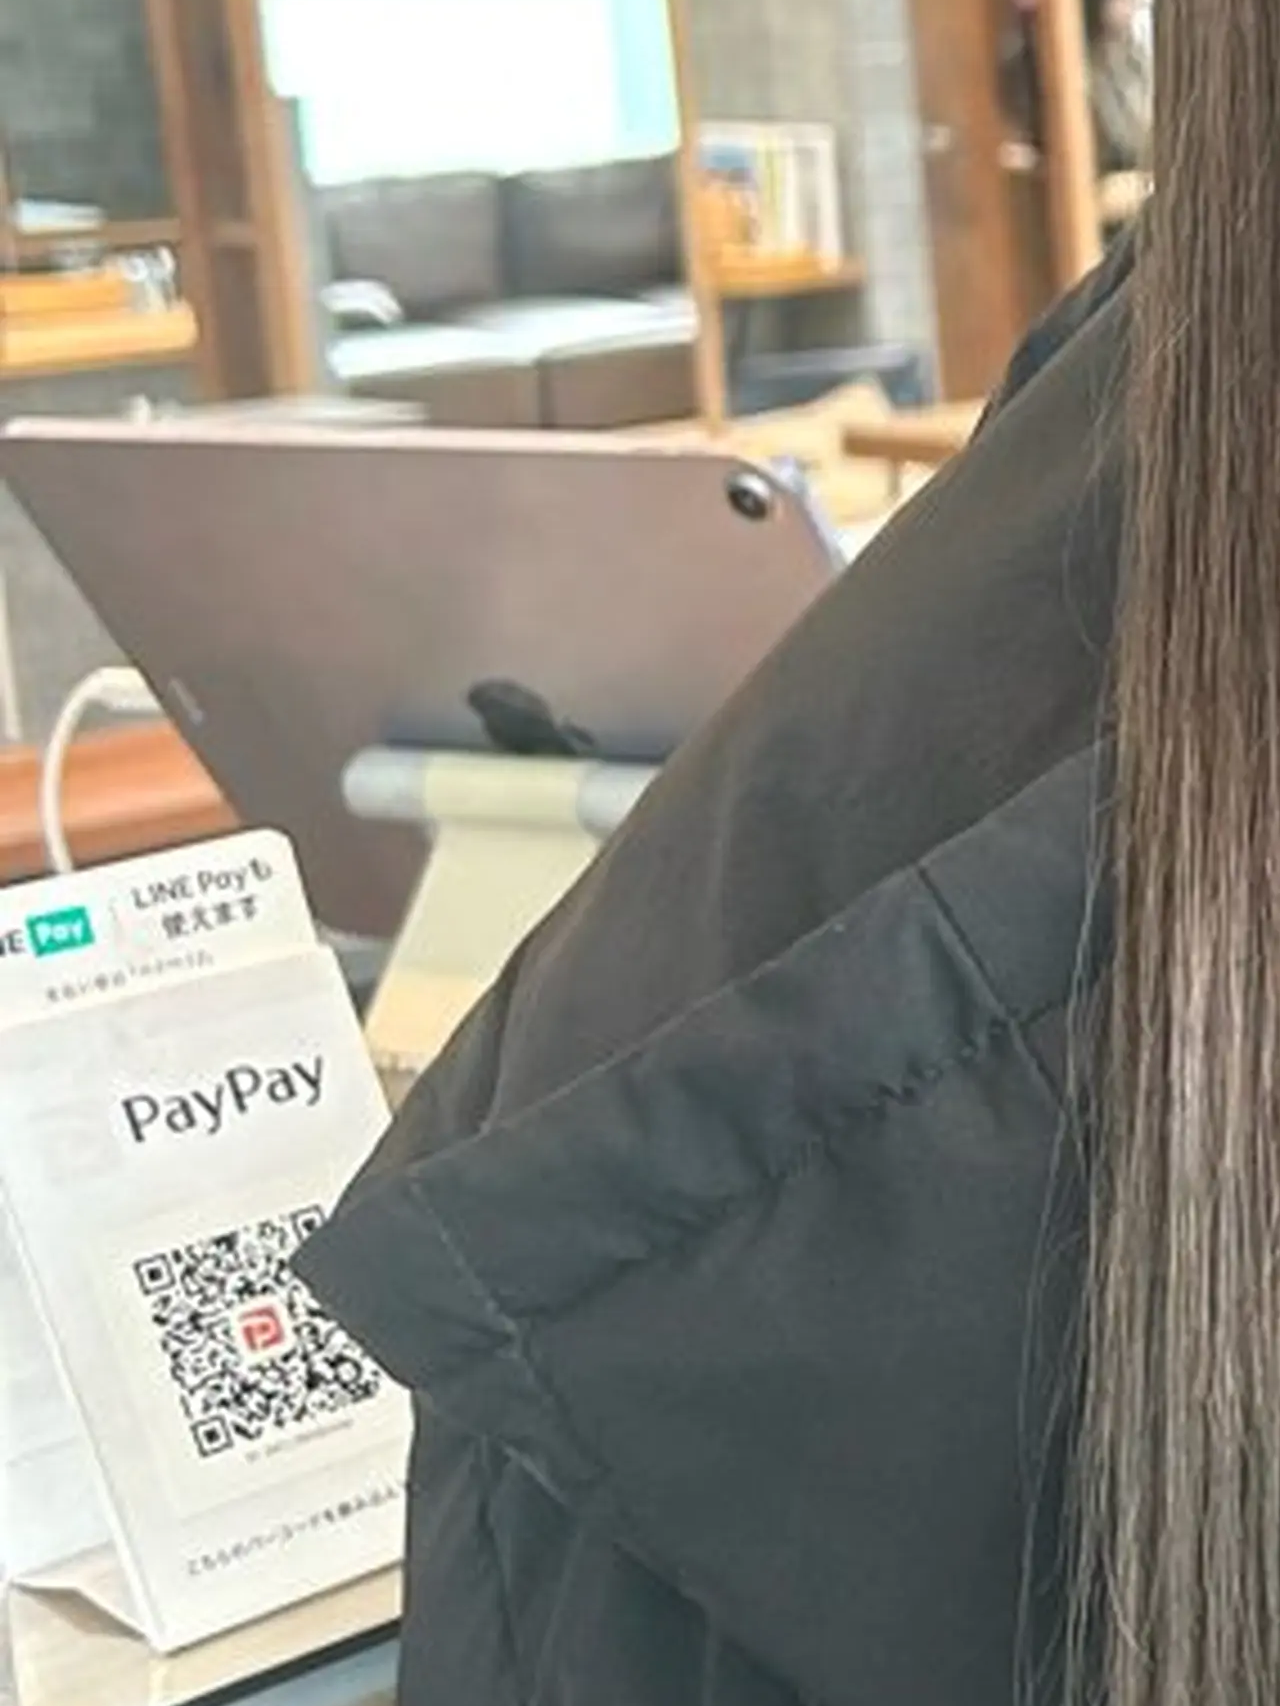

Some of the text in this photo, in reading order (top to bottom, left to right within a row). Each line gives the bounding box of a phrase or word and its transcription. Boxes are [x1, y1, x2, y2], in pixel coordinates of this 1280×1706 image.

[131, 874, 194, 910] LINE
[34, 916, 84, 947] Pay
[120, 1054, 324, 1144] PayPay
